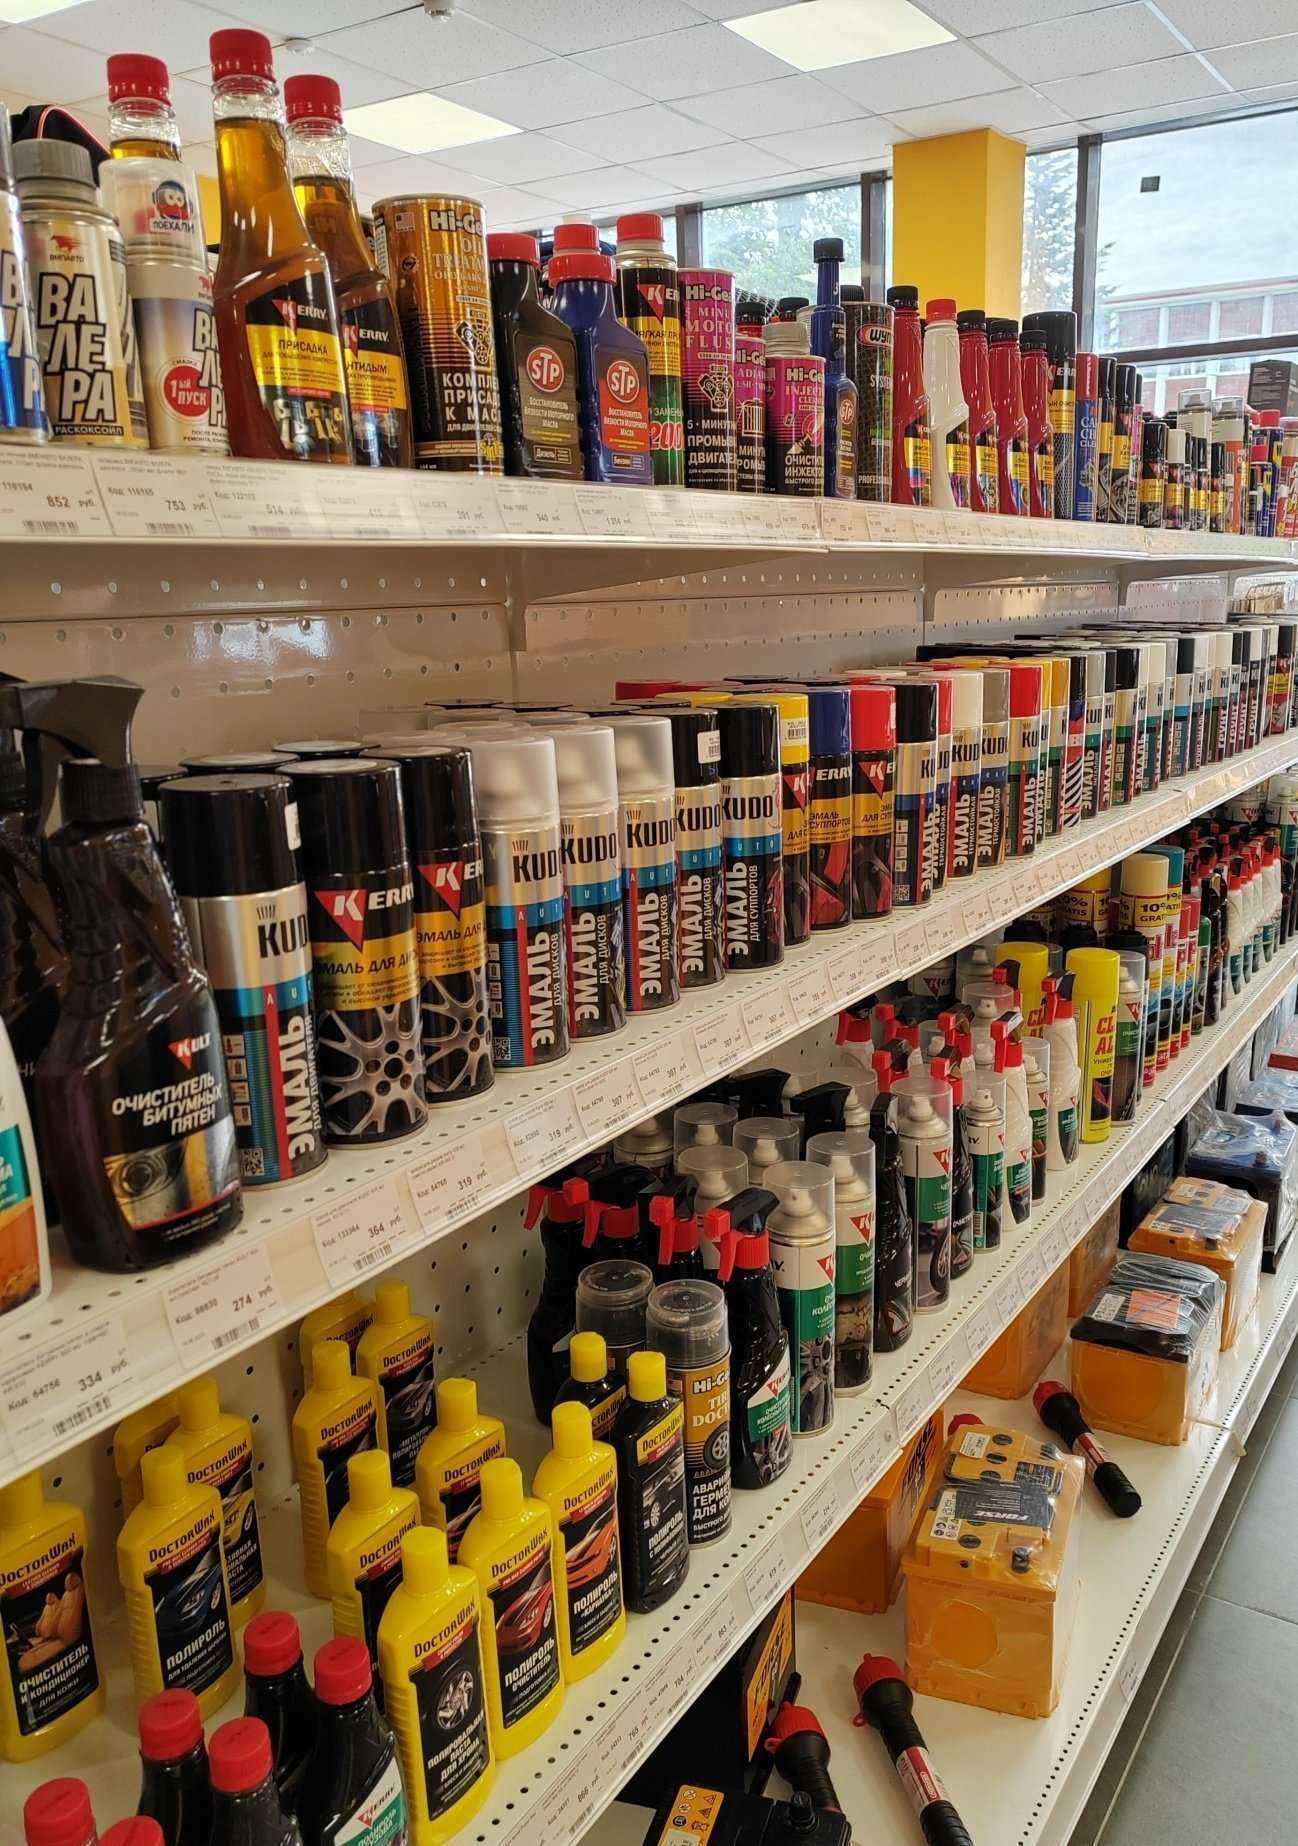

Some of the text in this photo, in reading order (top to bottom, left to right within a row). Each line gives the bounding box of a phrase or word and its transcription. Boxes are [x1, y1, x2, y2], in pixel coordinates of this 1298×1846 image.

[153, 219, 196, 234] ПОЕХАЛИ
[38, 272, 98, 329] ВА
[46, 320, 108, 374] ЛЕ
[278, 339, 329, 356] ПРИСАДКА
[531, 352, 560, 385] STP
[59, 368, 117, 422] РА
[177, 389, 207, 406] ПУСК
[610, 365, 636, 396] STP
[165, 499, 186, 511] 753
[721, 794, 774, 821] KUDO
[977, 785, 995, 858] ЭМАЛЬ
[561, 831, 619, 866] KUDO
[953, 793, 971, 868] ЭМАЛЬ
[680, 873, 704, 974] ЭМАЛЬ
[727, 861, 749, 958] ЭМАЛЬ
[416, 929, 461, 944] ЭМАЛЬ
[637, 891, 662, 999] ЭМАЛЬ
[367, 957, 396, 974] ДЛЯ
[570, 910, 600, 1023] ЭМАЛЬ
[527, 930, 556, 1050] ЭМАЛЬ
[112, 1071, 216, 1116] ОЧИСТИТЕЛЬ
[142, 1082, 223, 1128] БИТУМНЫХ
[278, 1014, 316, 1162] ЭМАЛЬ
[170, 1104, 217, 1136] ПЯТЕН
[457, 1176, 474, 1192] 319
[367, 1222, 386, 1240] 364
[232, 1293, 253, 1313] 274
[78, 1371, 103, 1392] 334
[692, 1504, 717, 1521] ДЛЯ
[573, 1571, 619, 1615] ПОЛИРОЛЬ
[166, 1618, 227, 1671] ПОЛИРОЛЬ
[505, 1638, 556, 1688] ПОЛИРОЛЬ
[19, 1644, 89, 1694] ОЧИСТИТЕЛЬ
